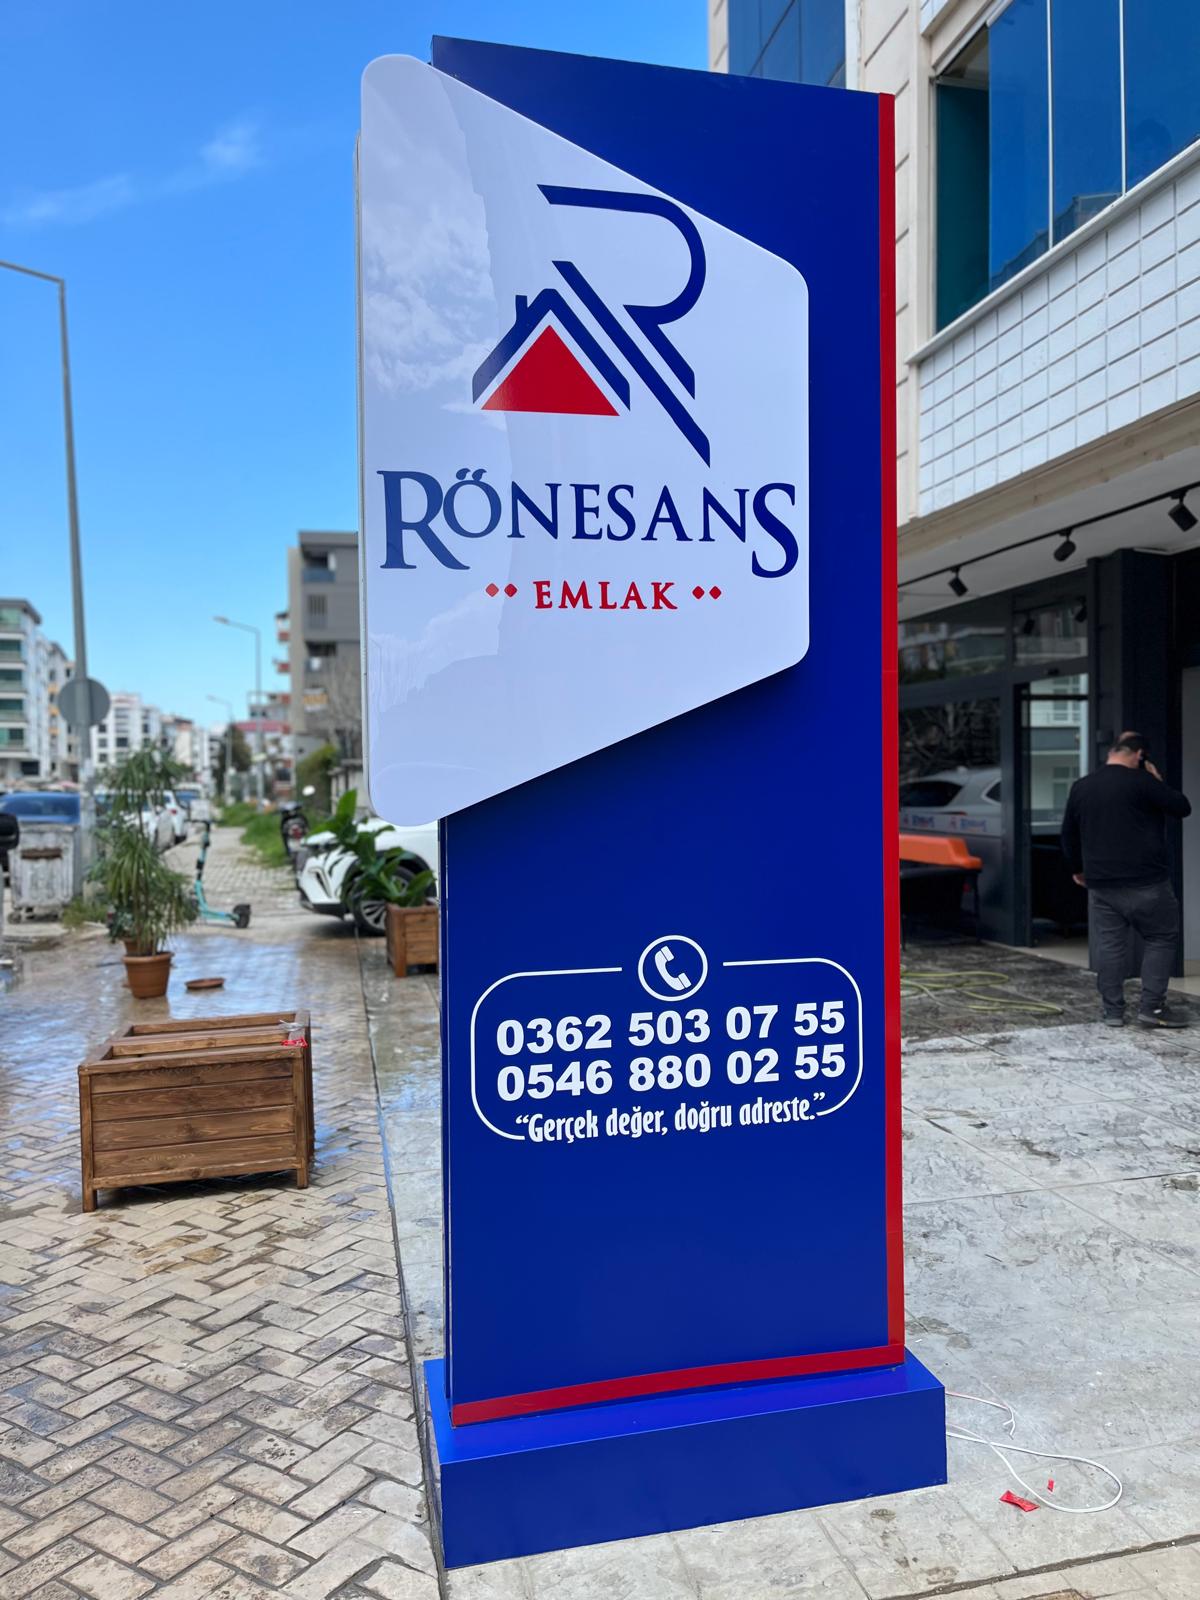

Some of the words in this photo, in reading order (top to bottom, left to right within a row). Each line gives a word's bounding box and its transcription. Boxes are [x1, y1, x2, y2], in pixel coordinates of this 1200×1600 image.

[376, 467, 799, 579] RÖNESANS
[533, 580, 678, 611] EMLAK
[496, 1014, 612, 1056] 0362
[628, 1008, 711, 1047] 503
[725, 1004, 779, 1041] 07
[793, 1000, 845, 1037] 55
[497, 1059, 613, 1102] 0546
[628, 1053, 712, 1092] 880
[726, 1047, 780, 1085] 02
[794, 1043, 846, 1080] 55
[605, 1105, 668, 1139] değer,
[674, 1100, 733, 1133] doğru
